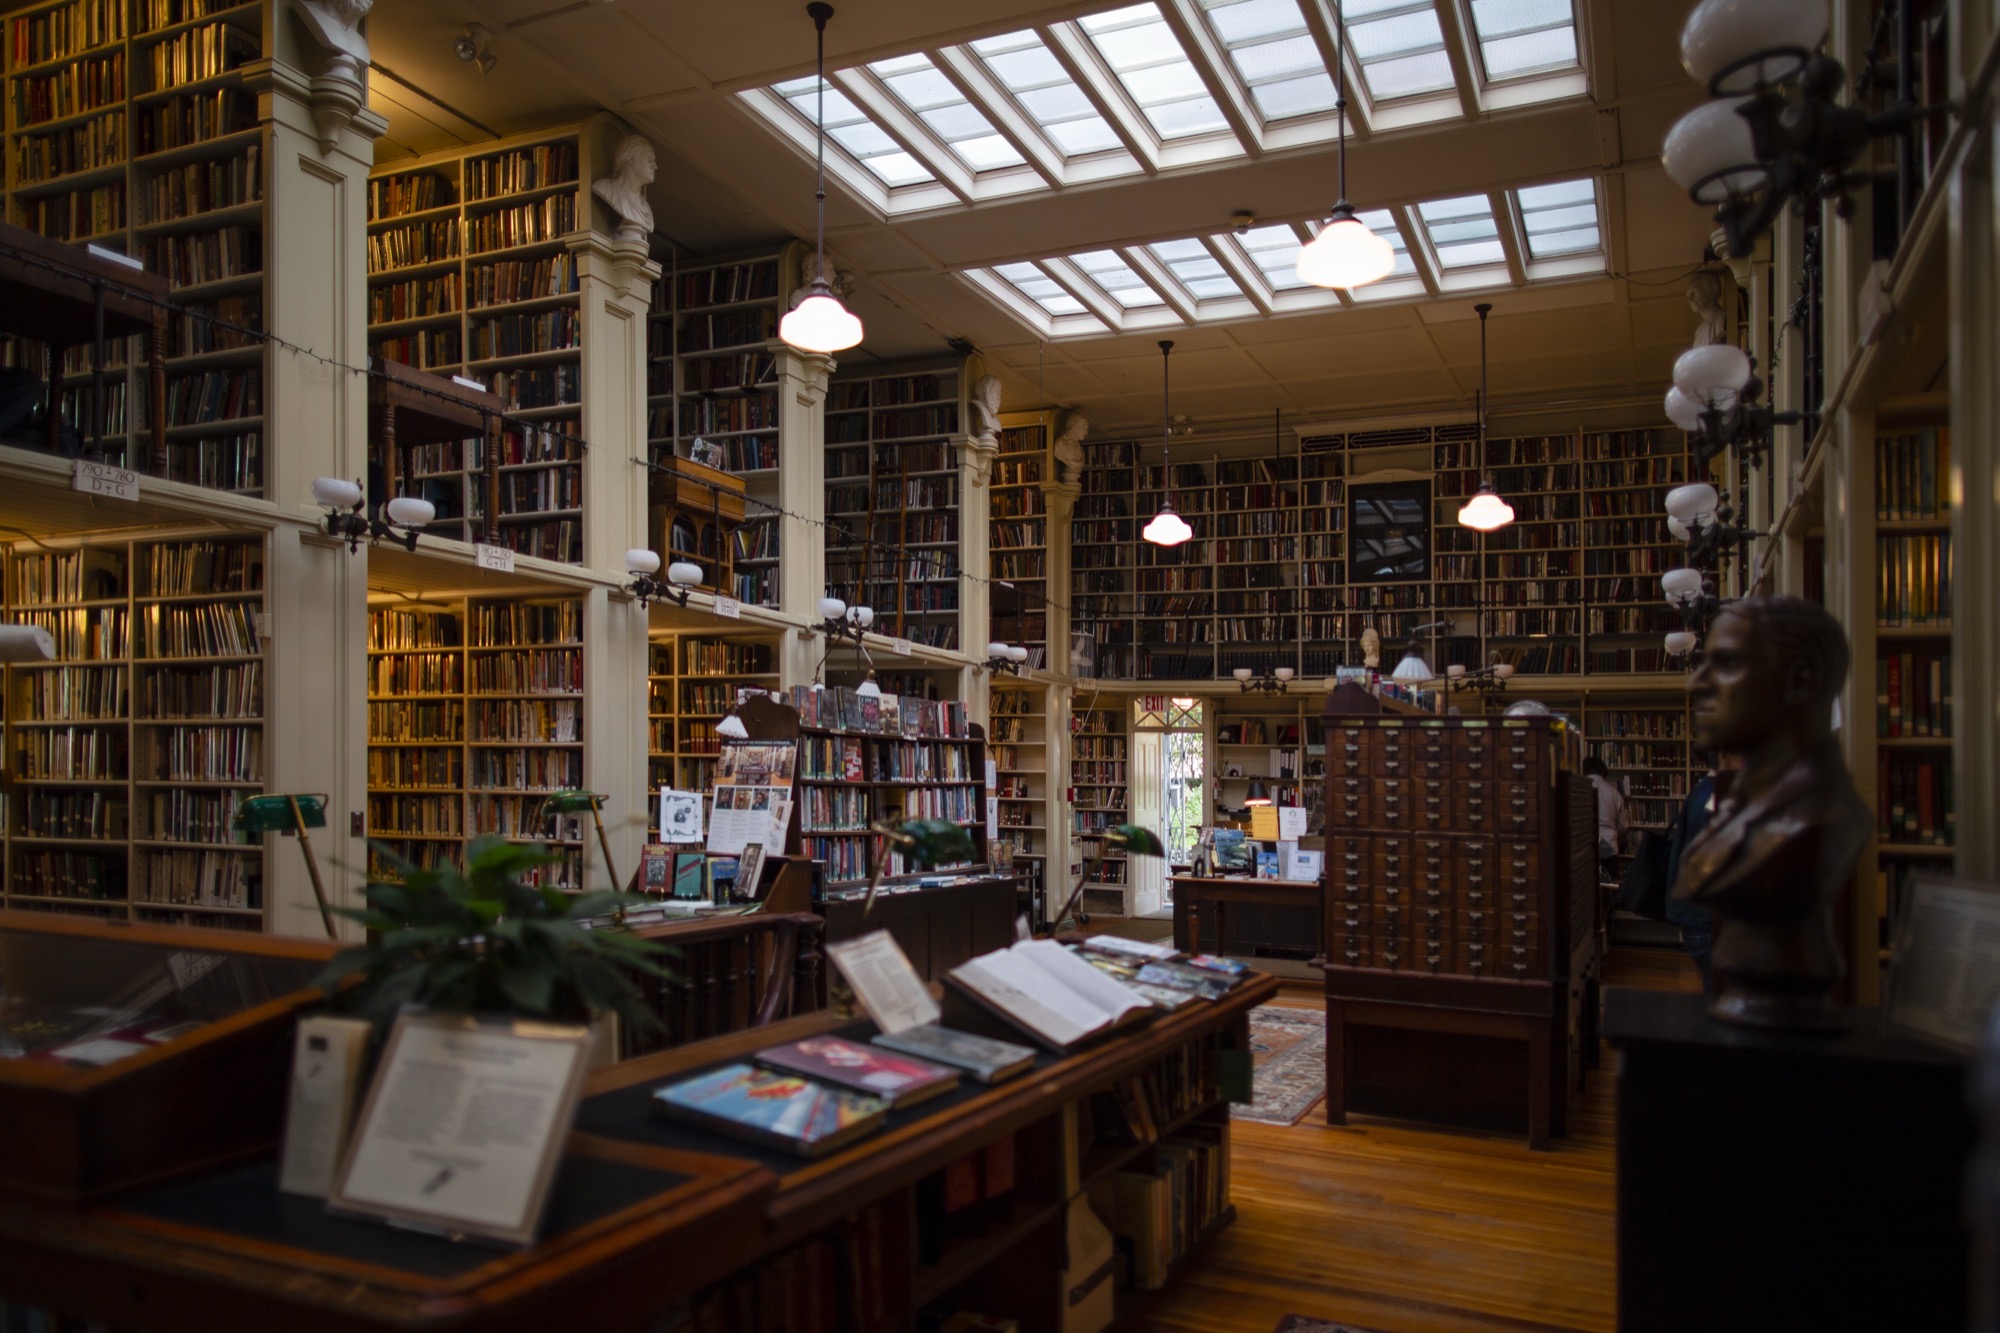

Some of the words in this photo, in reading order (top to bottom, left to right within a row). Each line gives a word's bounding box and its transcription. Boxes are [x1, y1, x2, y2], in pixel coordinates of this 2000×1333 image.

[81, 462, 103, 477] 790
[115, 469, 135, 483] 780
[92, 479, 102, 490] D
[115, 484, 125, 496] G
[500, 560, 506, 569] H
[1145, 695, 1165, 711] EXIT
